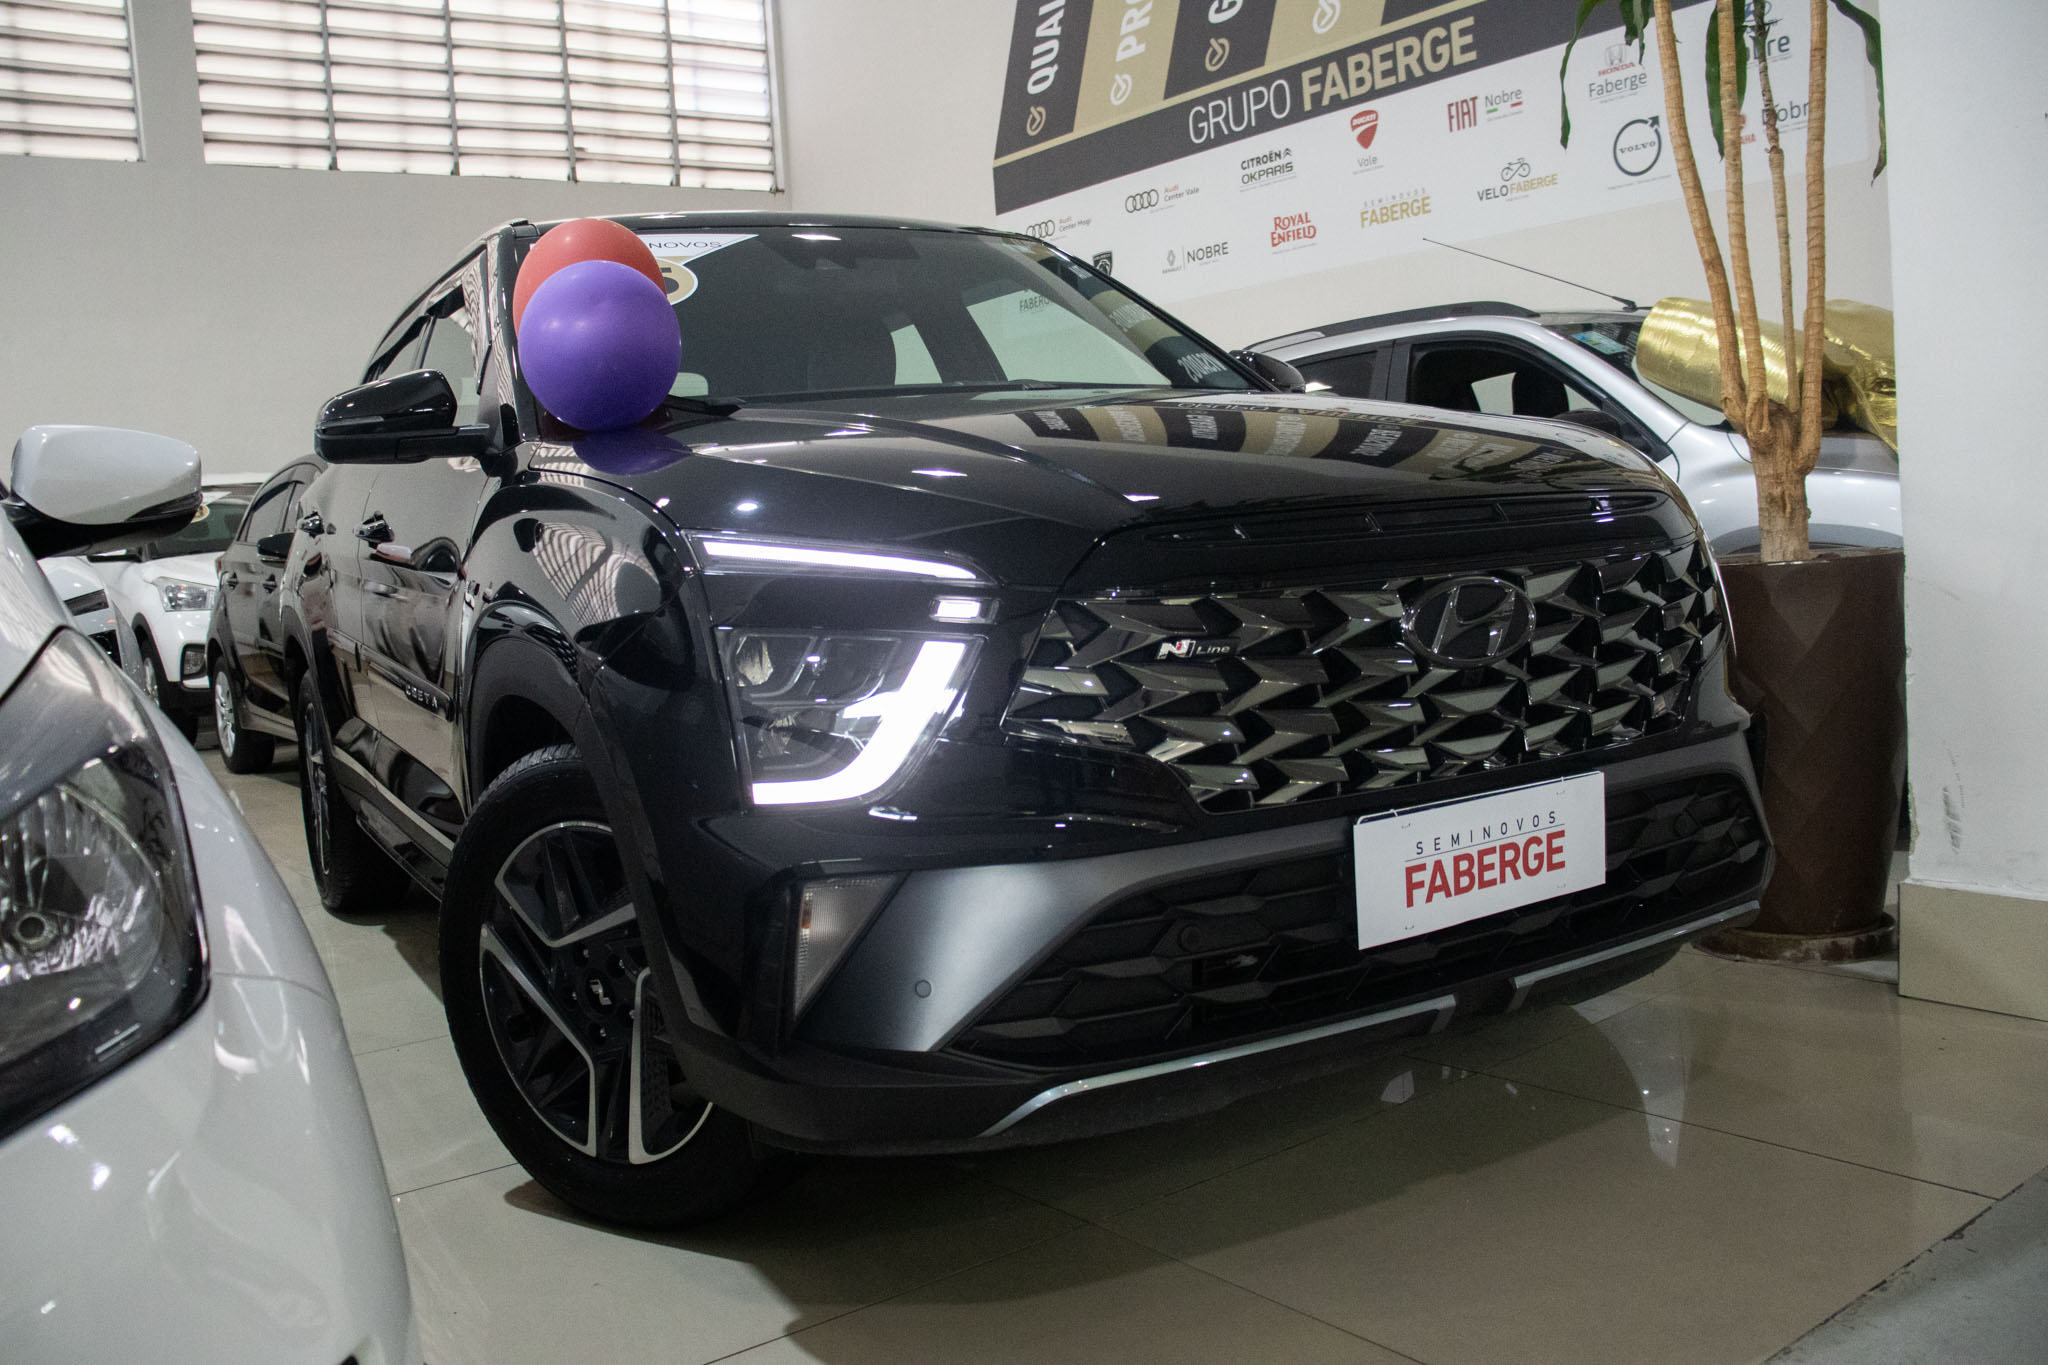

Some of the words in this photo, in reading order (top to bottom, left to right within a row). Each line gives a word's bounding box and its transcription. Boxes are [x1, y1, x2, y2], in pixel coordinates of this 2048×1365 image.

[1115, 0, 1154, 62] PR
[1188, 79, 1291, 144] GRUPO
[1300, 16, 1477, 112] FABERGE
[1598, 62, 1636, 76] HONDA
[1588, 72, 1648, 98] Faberge
[1447, 96, 1479, 132] FIAT
[1485, 88, 1523, 107] Nobre
[1619, 140, 1657, 154] VOLVO
[1240, 150, 1282, 171] CITROËN
[1357, 155, 1378, 168] Vale
[1241, 162, 1294, 185] OKPARIS
[1164, 185, 1180, 194] Audi
[1164, 191, 1185, 202] Center
[1273, 211, 1312, 232] ROYAL
[1360, 196, 1433, 229] FABERGE
[648, 241, 722, 249] NOVOS
[1271, 225, 1318, 248] ENFIELD
[1186, 241, 1229, 264] NOBRE
[1196, 645, 1231, 655] Line
[1415, 810, 1557, 855] SEMINOVOS
[1404, 829, 1566, 909] FABERGE
